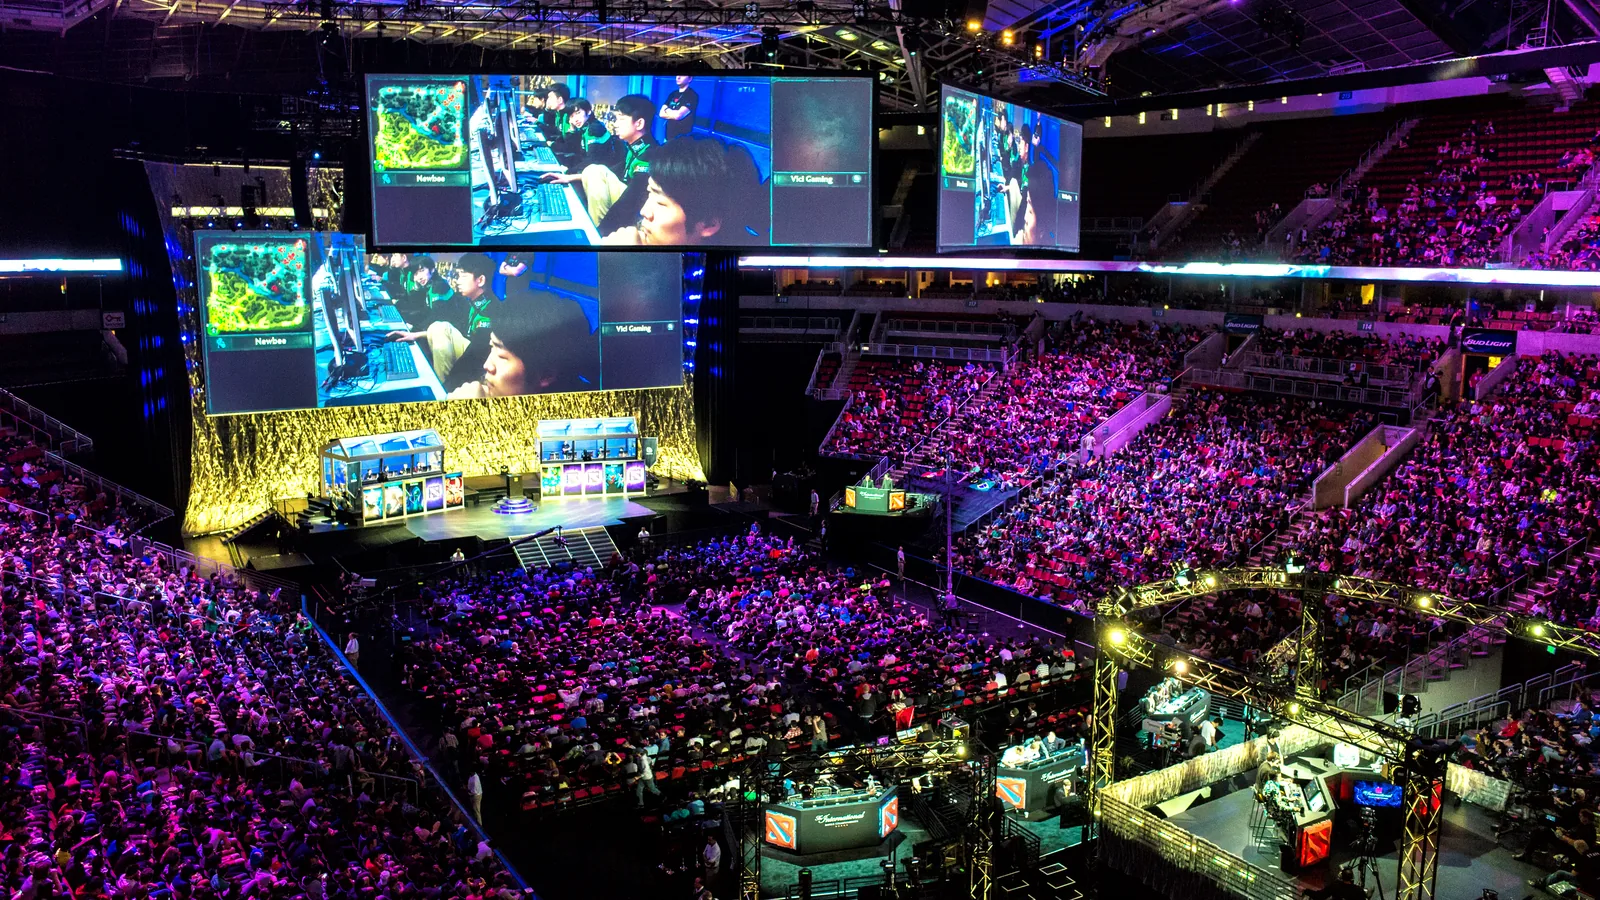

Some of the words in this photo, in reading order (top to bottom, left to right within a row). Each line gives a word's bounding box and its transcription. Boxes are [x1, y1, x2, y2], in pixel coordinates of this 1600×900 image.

[416, 174, 446, 183] Newbee
[790, 175, 805, 183] Vici
[805, 175, 834, 185] Gaming
[615, 325, 628, 333] Vici
[628, 324, 652, 333] Gaming
[254, 337, 287, 346] Newbee
[1485, 340, 1513, 348] LIGHT
[818, 811, 866, 824] International
